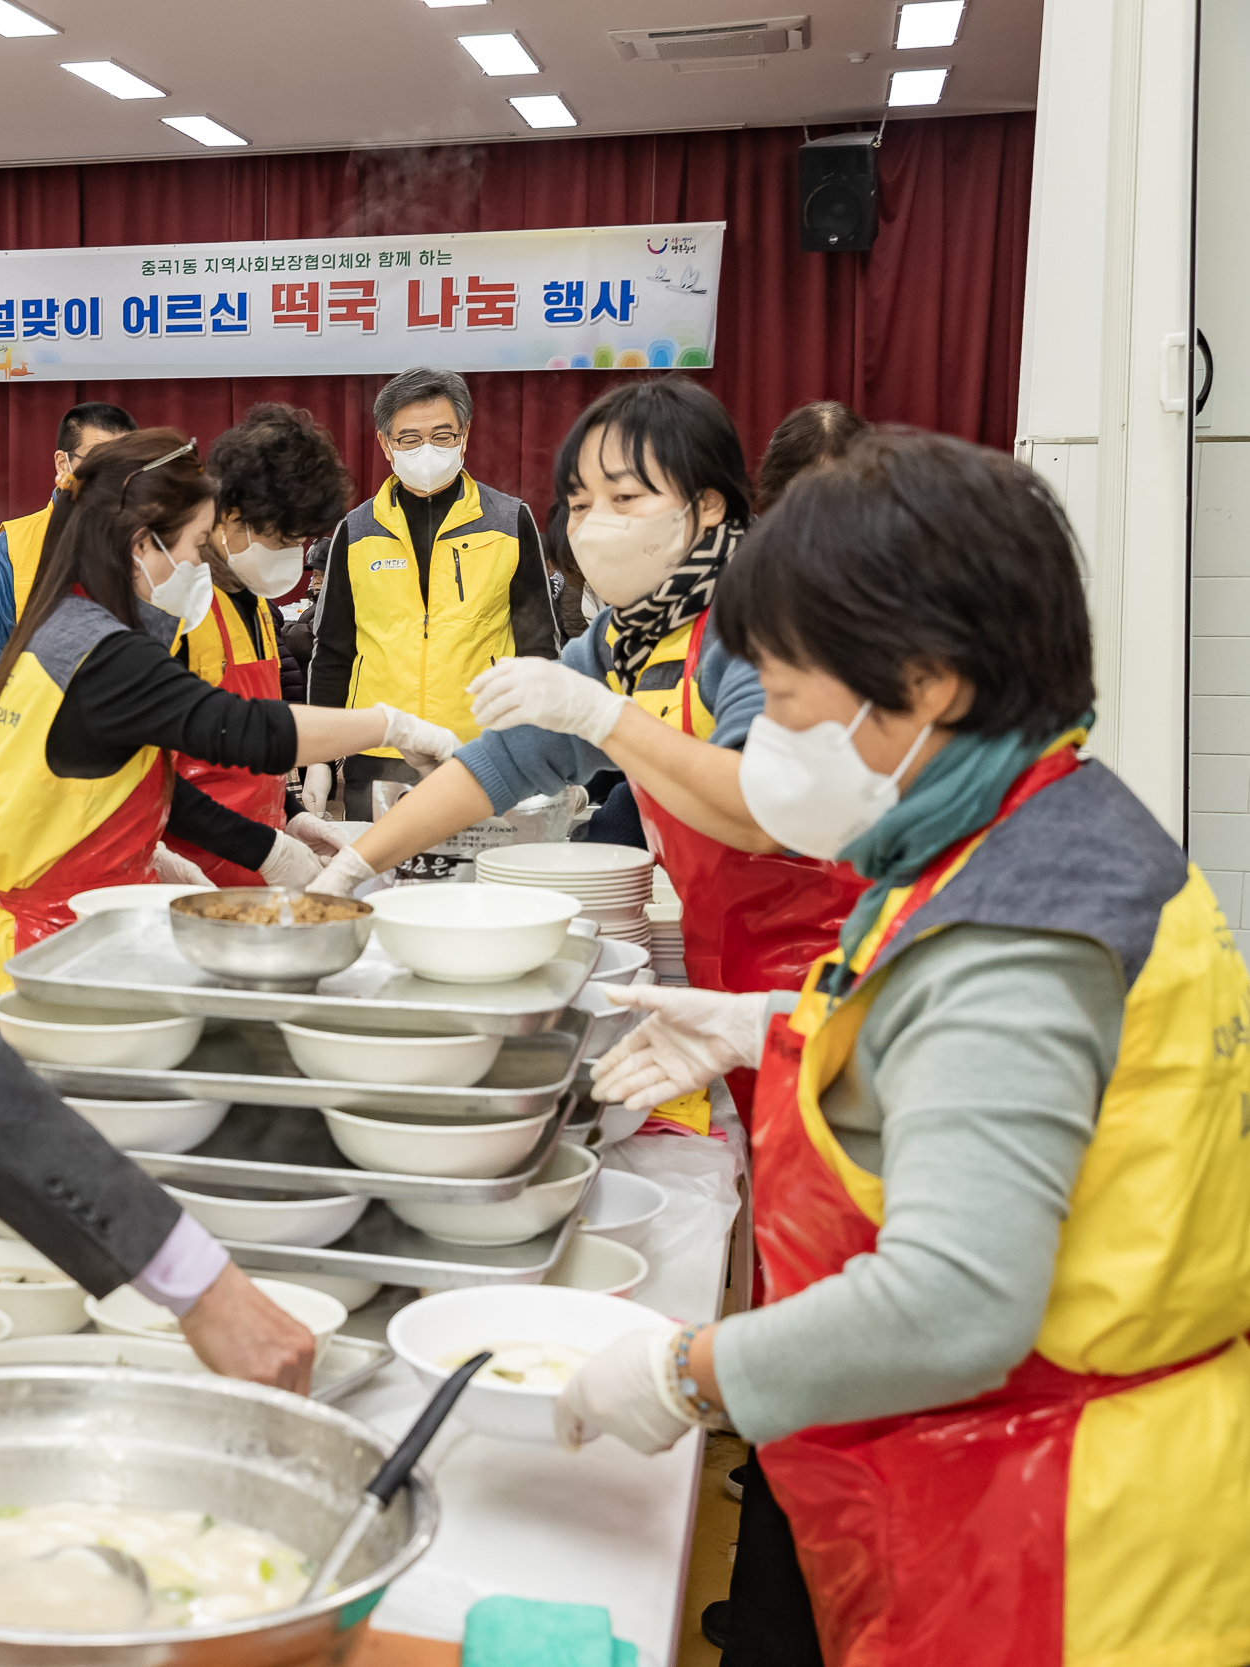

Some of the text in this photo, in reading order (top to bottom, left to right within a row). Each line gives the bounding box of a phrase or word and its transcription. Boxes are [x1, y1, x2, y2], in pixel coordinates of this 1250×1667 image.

[141, 250, 453, 276] 중곡1동 지역사회보장협의체와 함께 하는
[122, 291, 249, 336] 어르신
[271, 279, 378, 333] 떡국
[406, 275, 517, 329] 나눔
[542, 279, 636, 323] 행사
